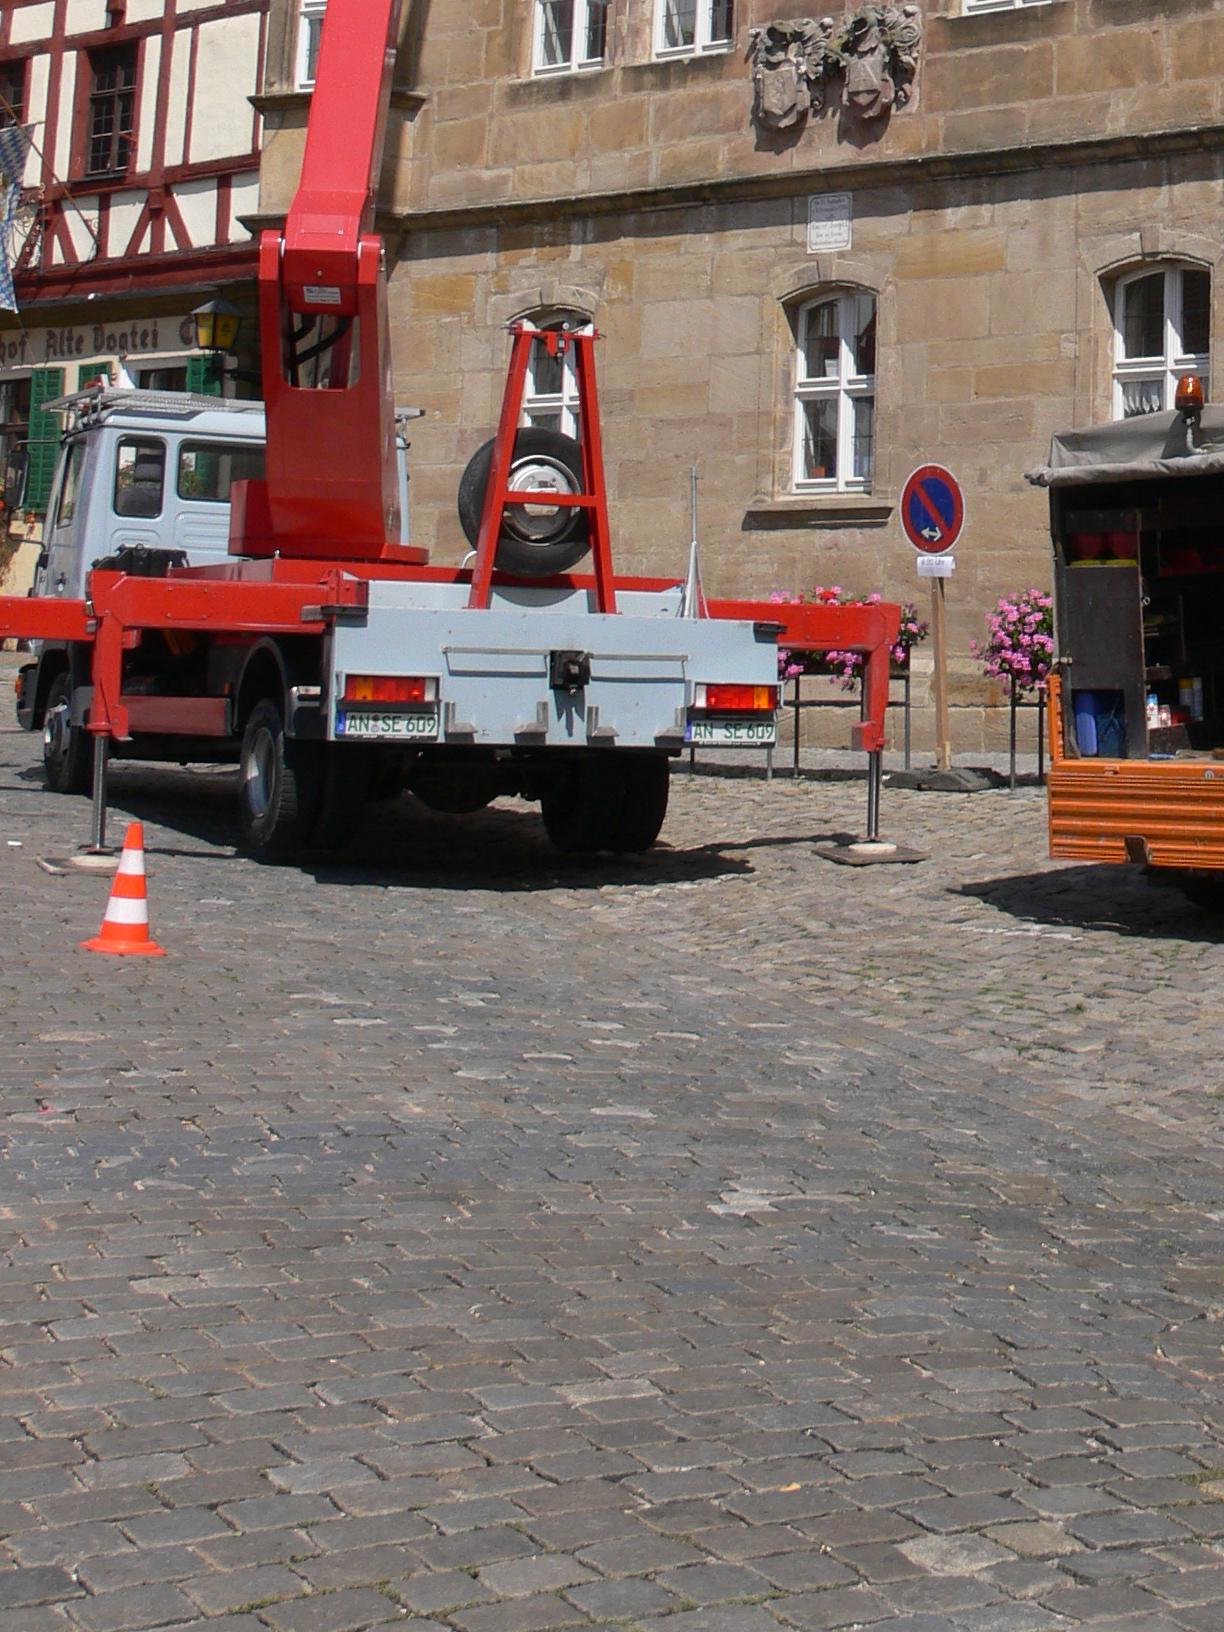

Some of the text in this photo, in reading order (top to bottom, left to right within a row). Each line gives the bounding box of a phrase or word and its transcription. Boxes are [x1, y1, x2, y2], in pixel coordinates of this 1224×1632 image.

[45, 327, 84, 364] Alte
[92, 320, 159, 355] Vogtei
[347, 714, 436, 733] AN SE 609
[693, 722, 774, 740] AN SE 609
